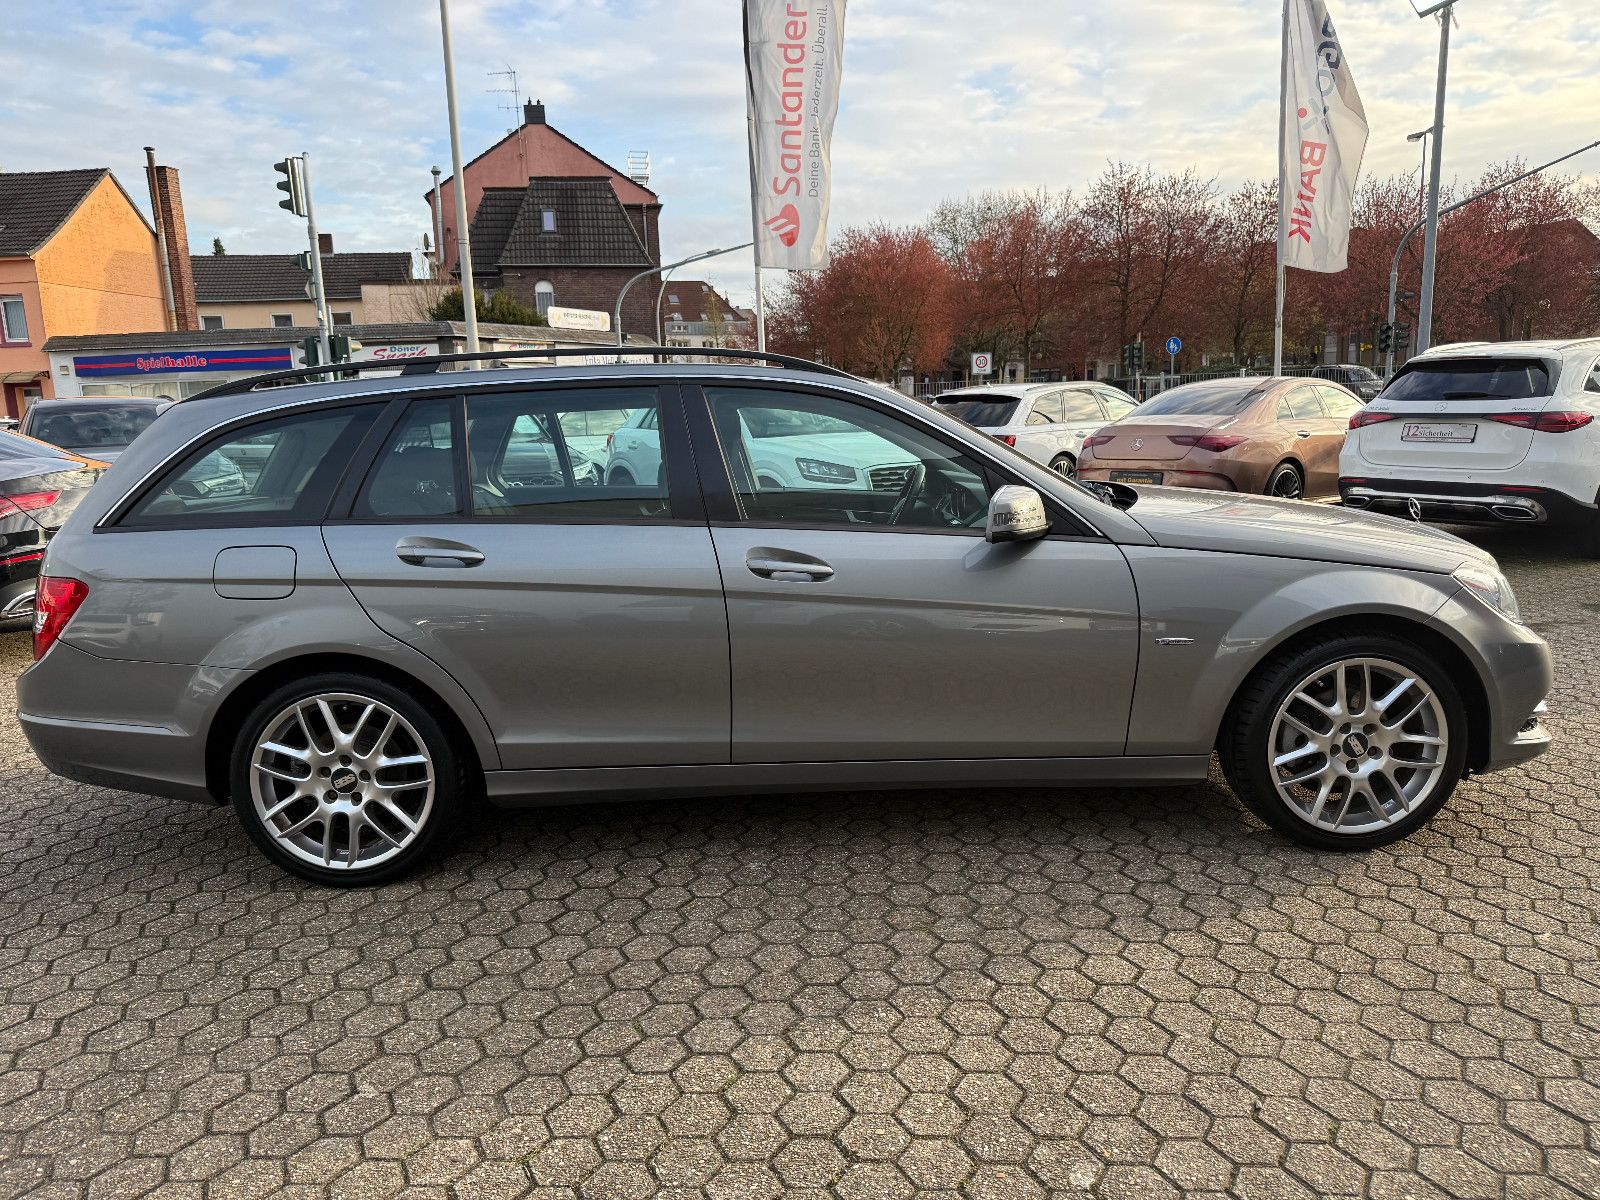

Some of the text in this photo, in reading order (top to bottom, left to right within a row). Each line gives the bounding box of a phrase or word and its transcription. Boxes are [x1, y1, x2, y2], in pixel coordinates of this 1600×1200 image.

[811, 4, 829, 55] Überall.
[772, 3, 808, 198] Santander
[808, 158, 820, 198] Deine
[136, 355, 207, 372] Spielhalle
[1404, 424, 1453, 437] 12 Sicherheit
[333, 773, 356, 789] BBS
